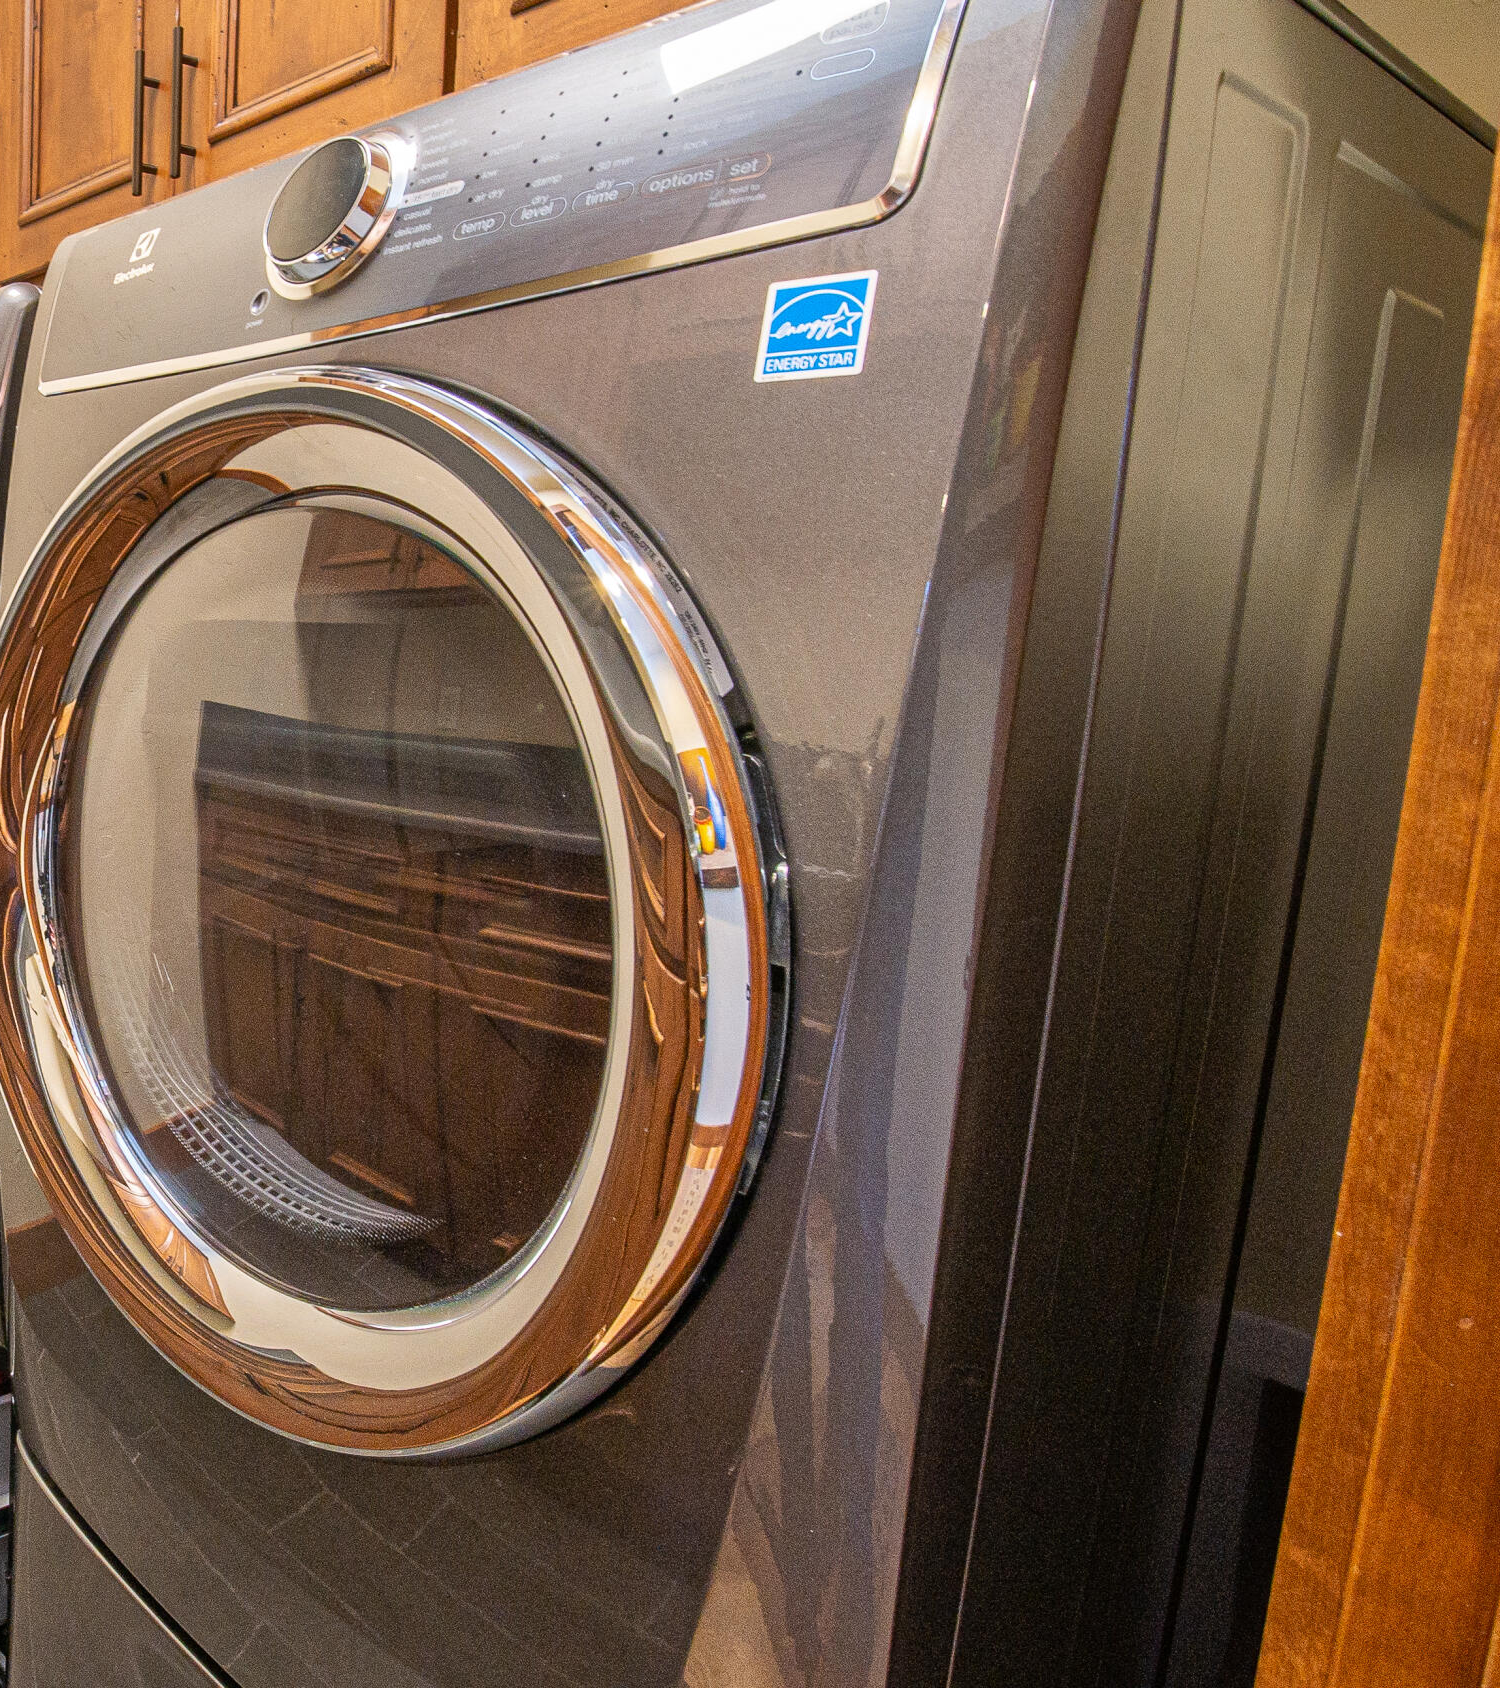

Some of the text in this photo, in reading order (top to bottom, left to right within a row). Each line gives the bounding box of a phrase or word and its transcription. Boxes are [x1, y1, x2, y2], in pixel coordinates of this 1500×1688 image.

[649, 159, 759, 193] options set
[596, 180, 616, 191] dry
[531, 194, 550, 206] dry
[586, 189, 619, 206] time
[403, 206, 433, 221] casual
[521, 202, 554, 221] level
[393, 222, 433, 238] delicates
[461, 218, 496, 235] temp
[412, 234, 443, 248] refresh
[113, 262, 156, 285] Electrolux
[765, 351, 854, 372] ENERGY STAR
